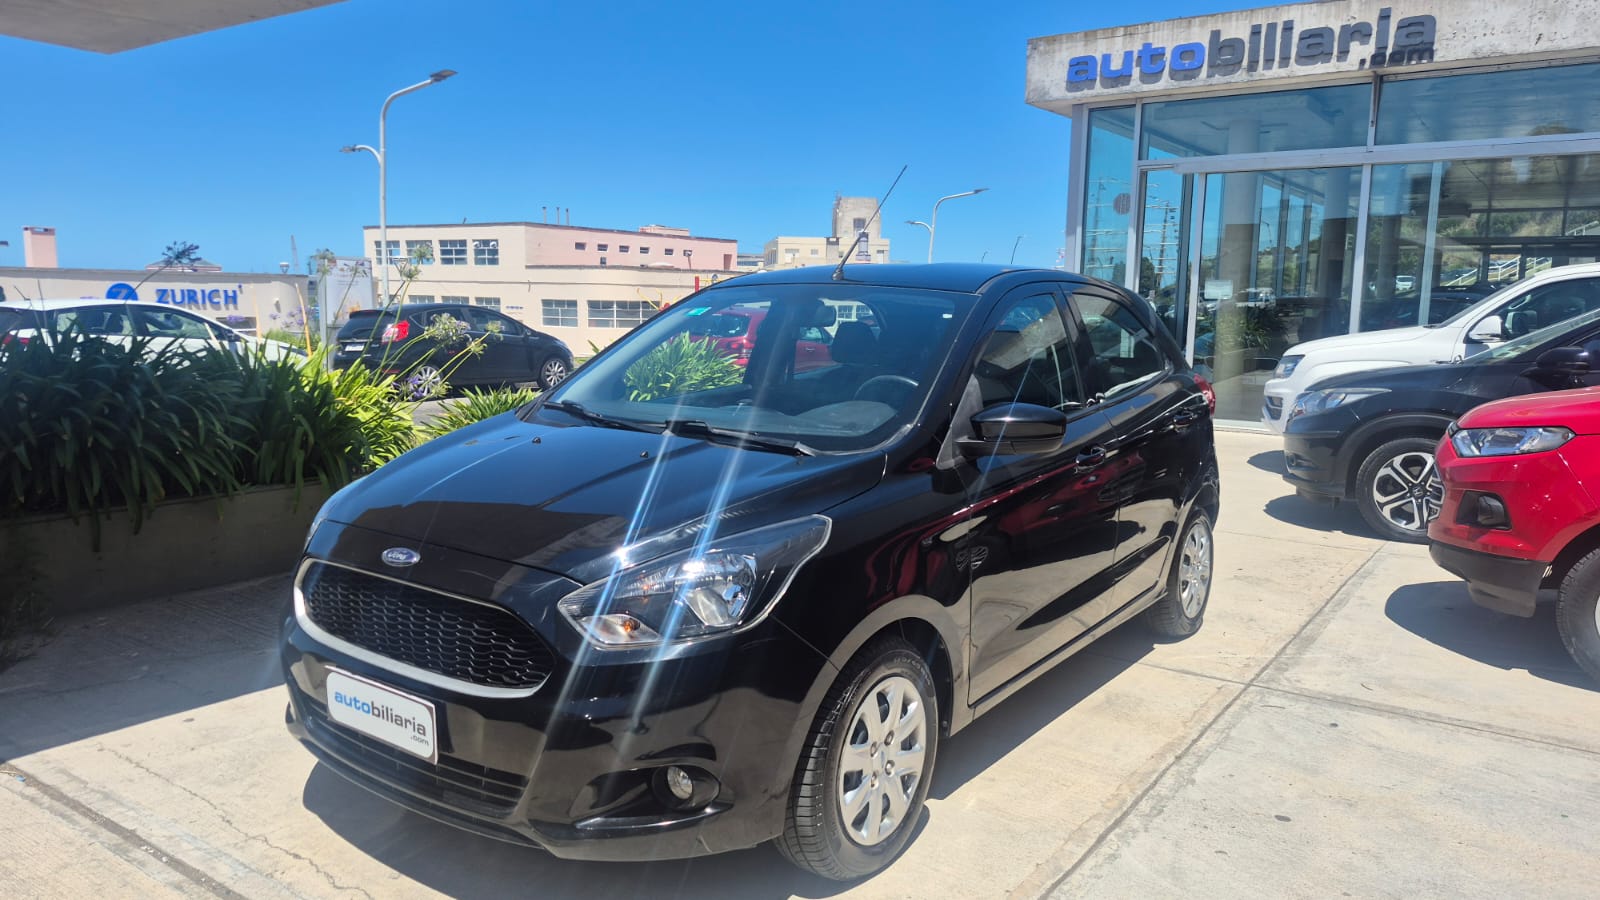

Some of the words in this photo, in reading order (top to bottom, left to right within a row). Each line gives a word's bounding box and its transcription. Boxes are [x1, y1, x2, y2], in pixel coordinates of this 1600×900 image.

[1066, 6, 1437, 85] autobiliaria
[154, 288, 239, 306] ZURICH
[334, 691, 427, 737] autobiliaria
